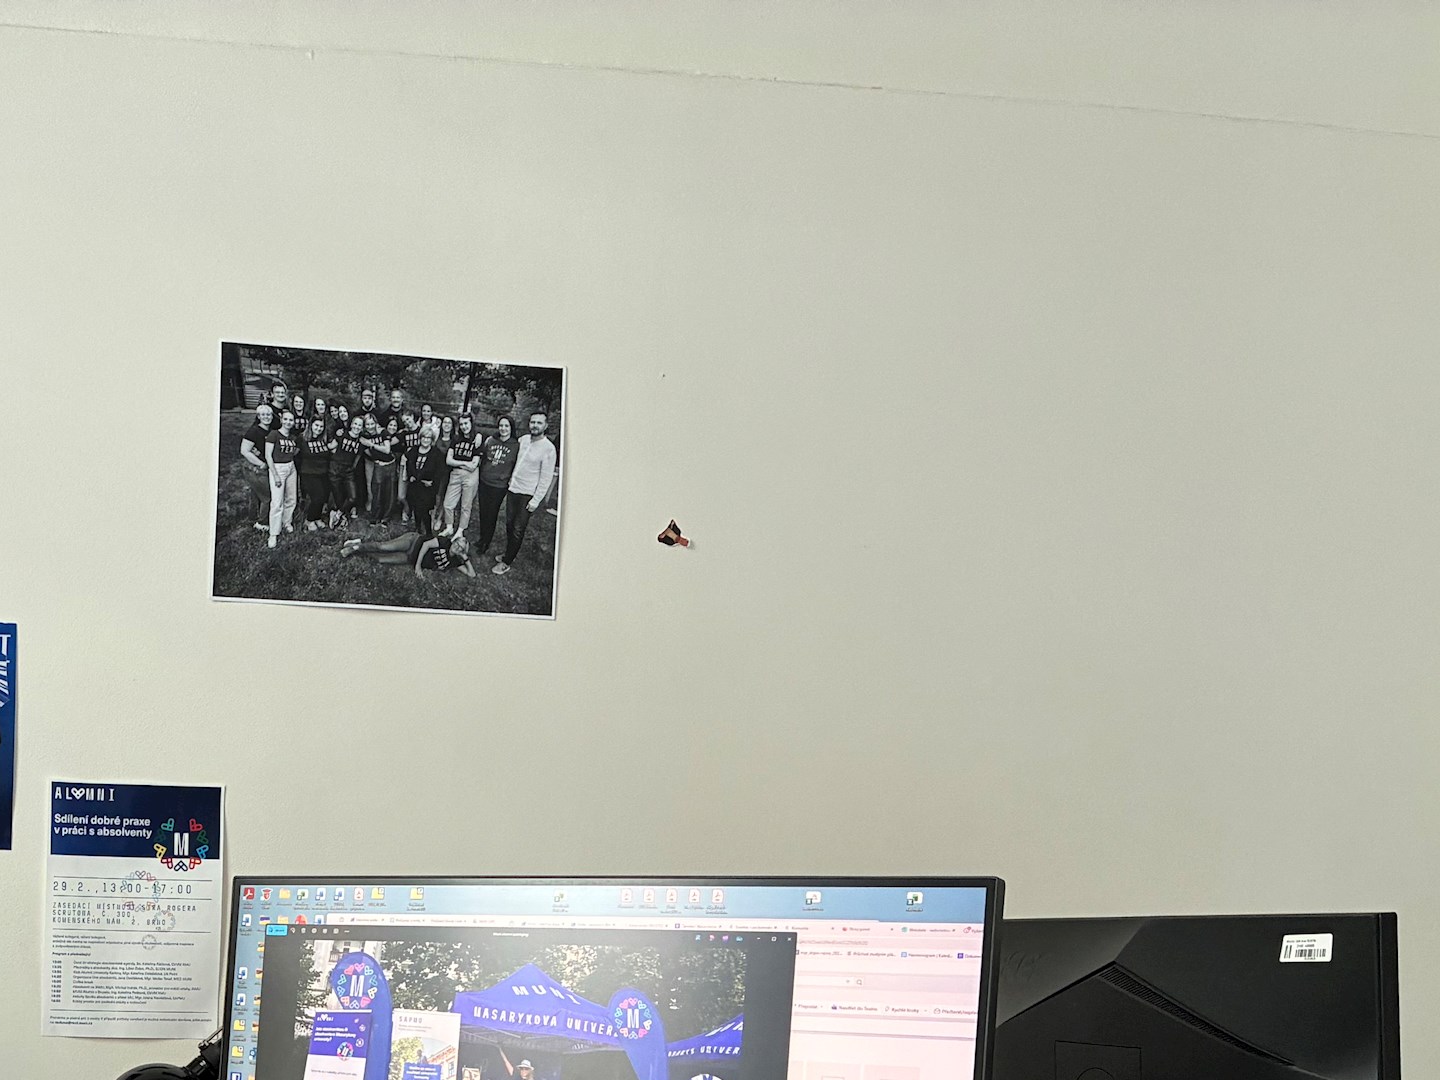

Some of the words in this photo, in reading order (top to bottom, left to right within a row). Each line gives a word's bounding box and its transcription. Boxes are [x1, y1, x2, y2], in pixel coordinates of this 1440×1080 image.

[54, 813, 89, 824] Sdílení
[91, 815, 120, 826] dobré
[122, 818, 151, 828] praxe
[62, 825, 87, 837] práci
[89, 828, 95, 836] s
[97, 826, 152, 839] absolventy
[173, 832, 189, 856] M
[512, 984, 581, 1006] MUNI
[473, 1005, 558, 1028] MASARYKOVA
[566, 1018, 619, 1038] UNIVER
